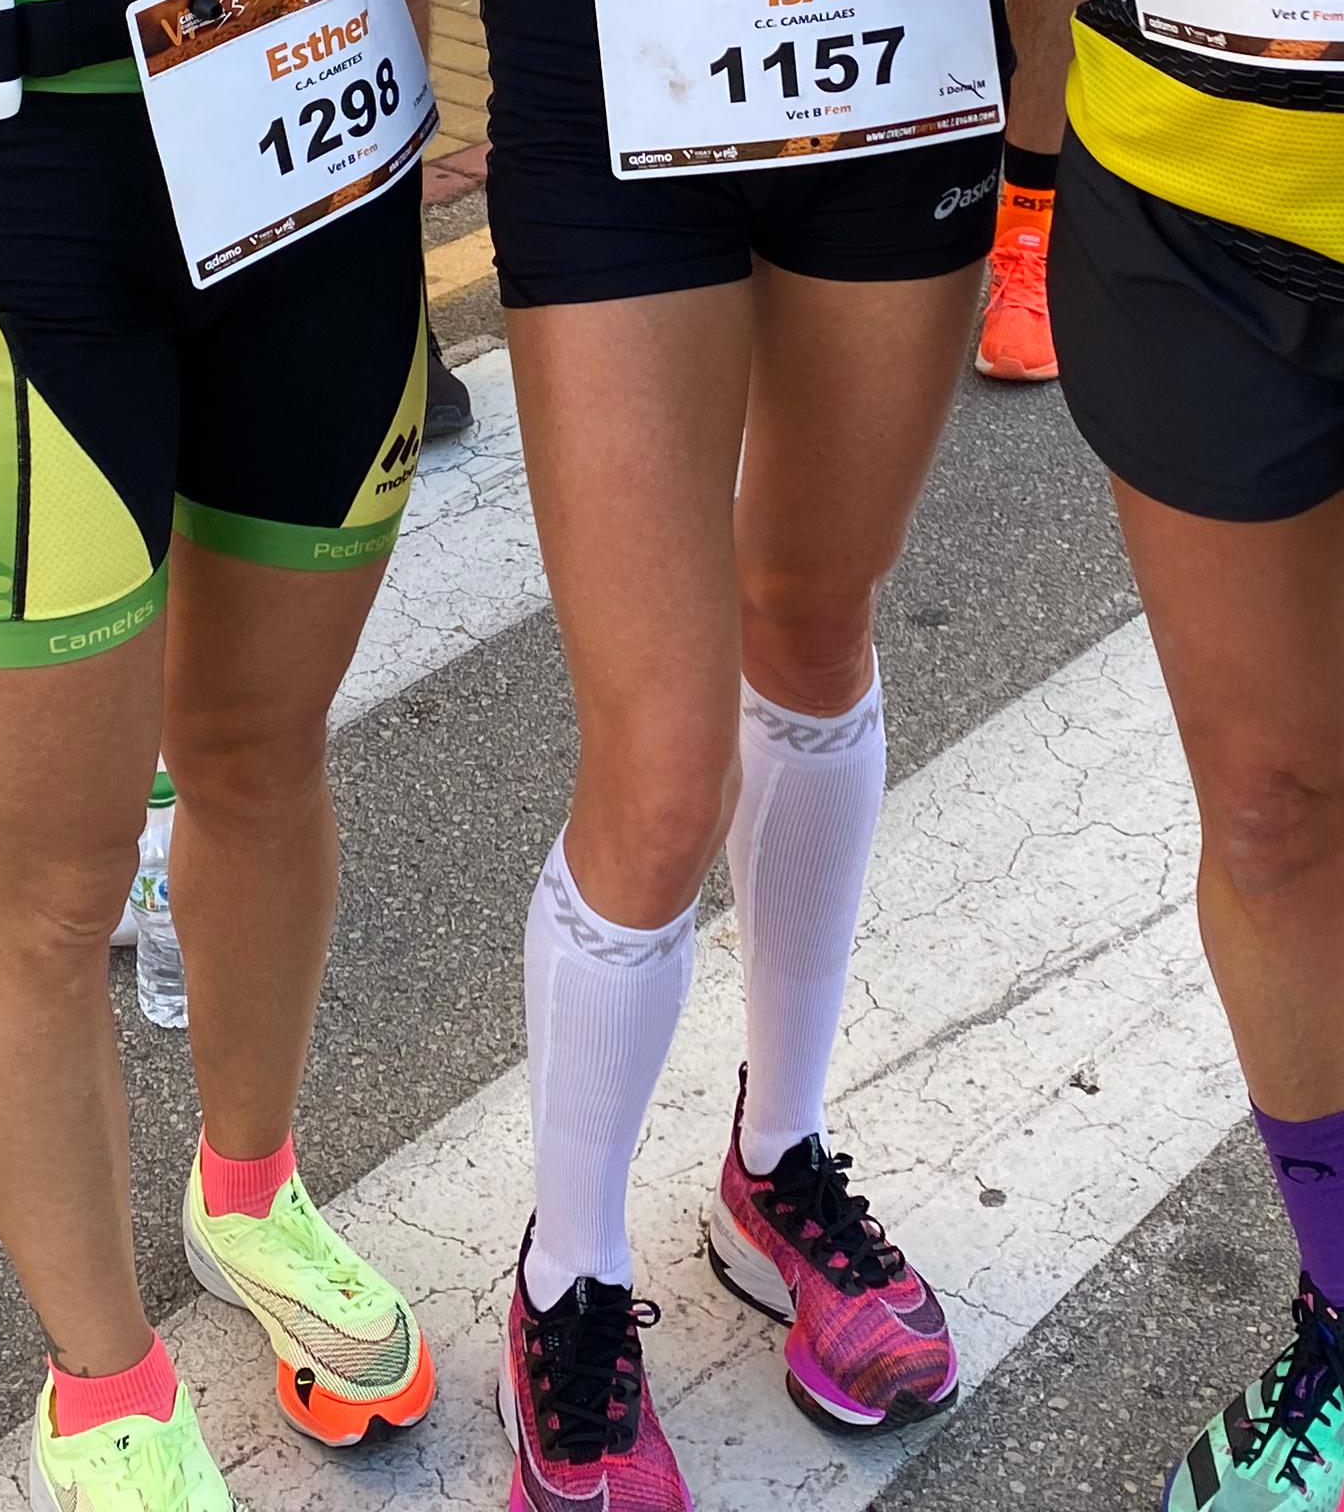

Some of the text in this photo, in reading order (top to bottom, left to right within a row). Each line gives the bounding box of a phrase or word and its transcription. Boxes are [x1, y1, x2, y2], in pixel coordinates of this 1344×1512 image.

[755, 8, 855, 29] C.C. CAMALLAES
[1272, 9, 1344, 21] Vet C Fem
[266, 9, 369, 81] Esther
[295, 52, 363, 91] C.A. CAMETES
[710, 26, 905, 103] 1157
[258, 57, 400, 176] 1298
[786, 105, 851, 120] Vet B Fem
[327, 143, 378, 175] Vet B Fem
[629, 153, 673, 165] adamo
[204, 245, 242, 271] adamo
